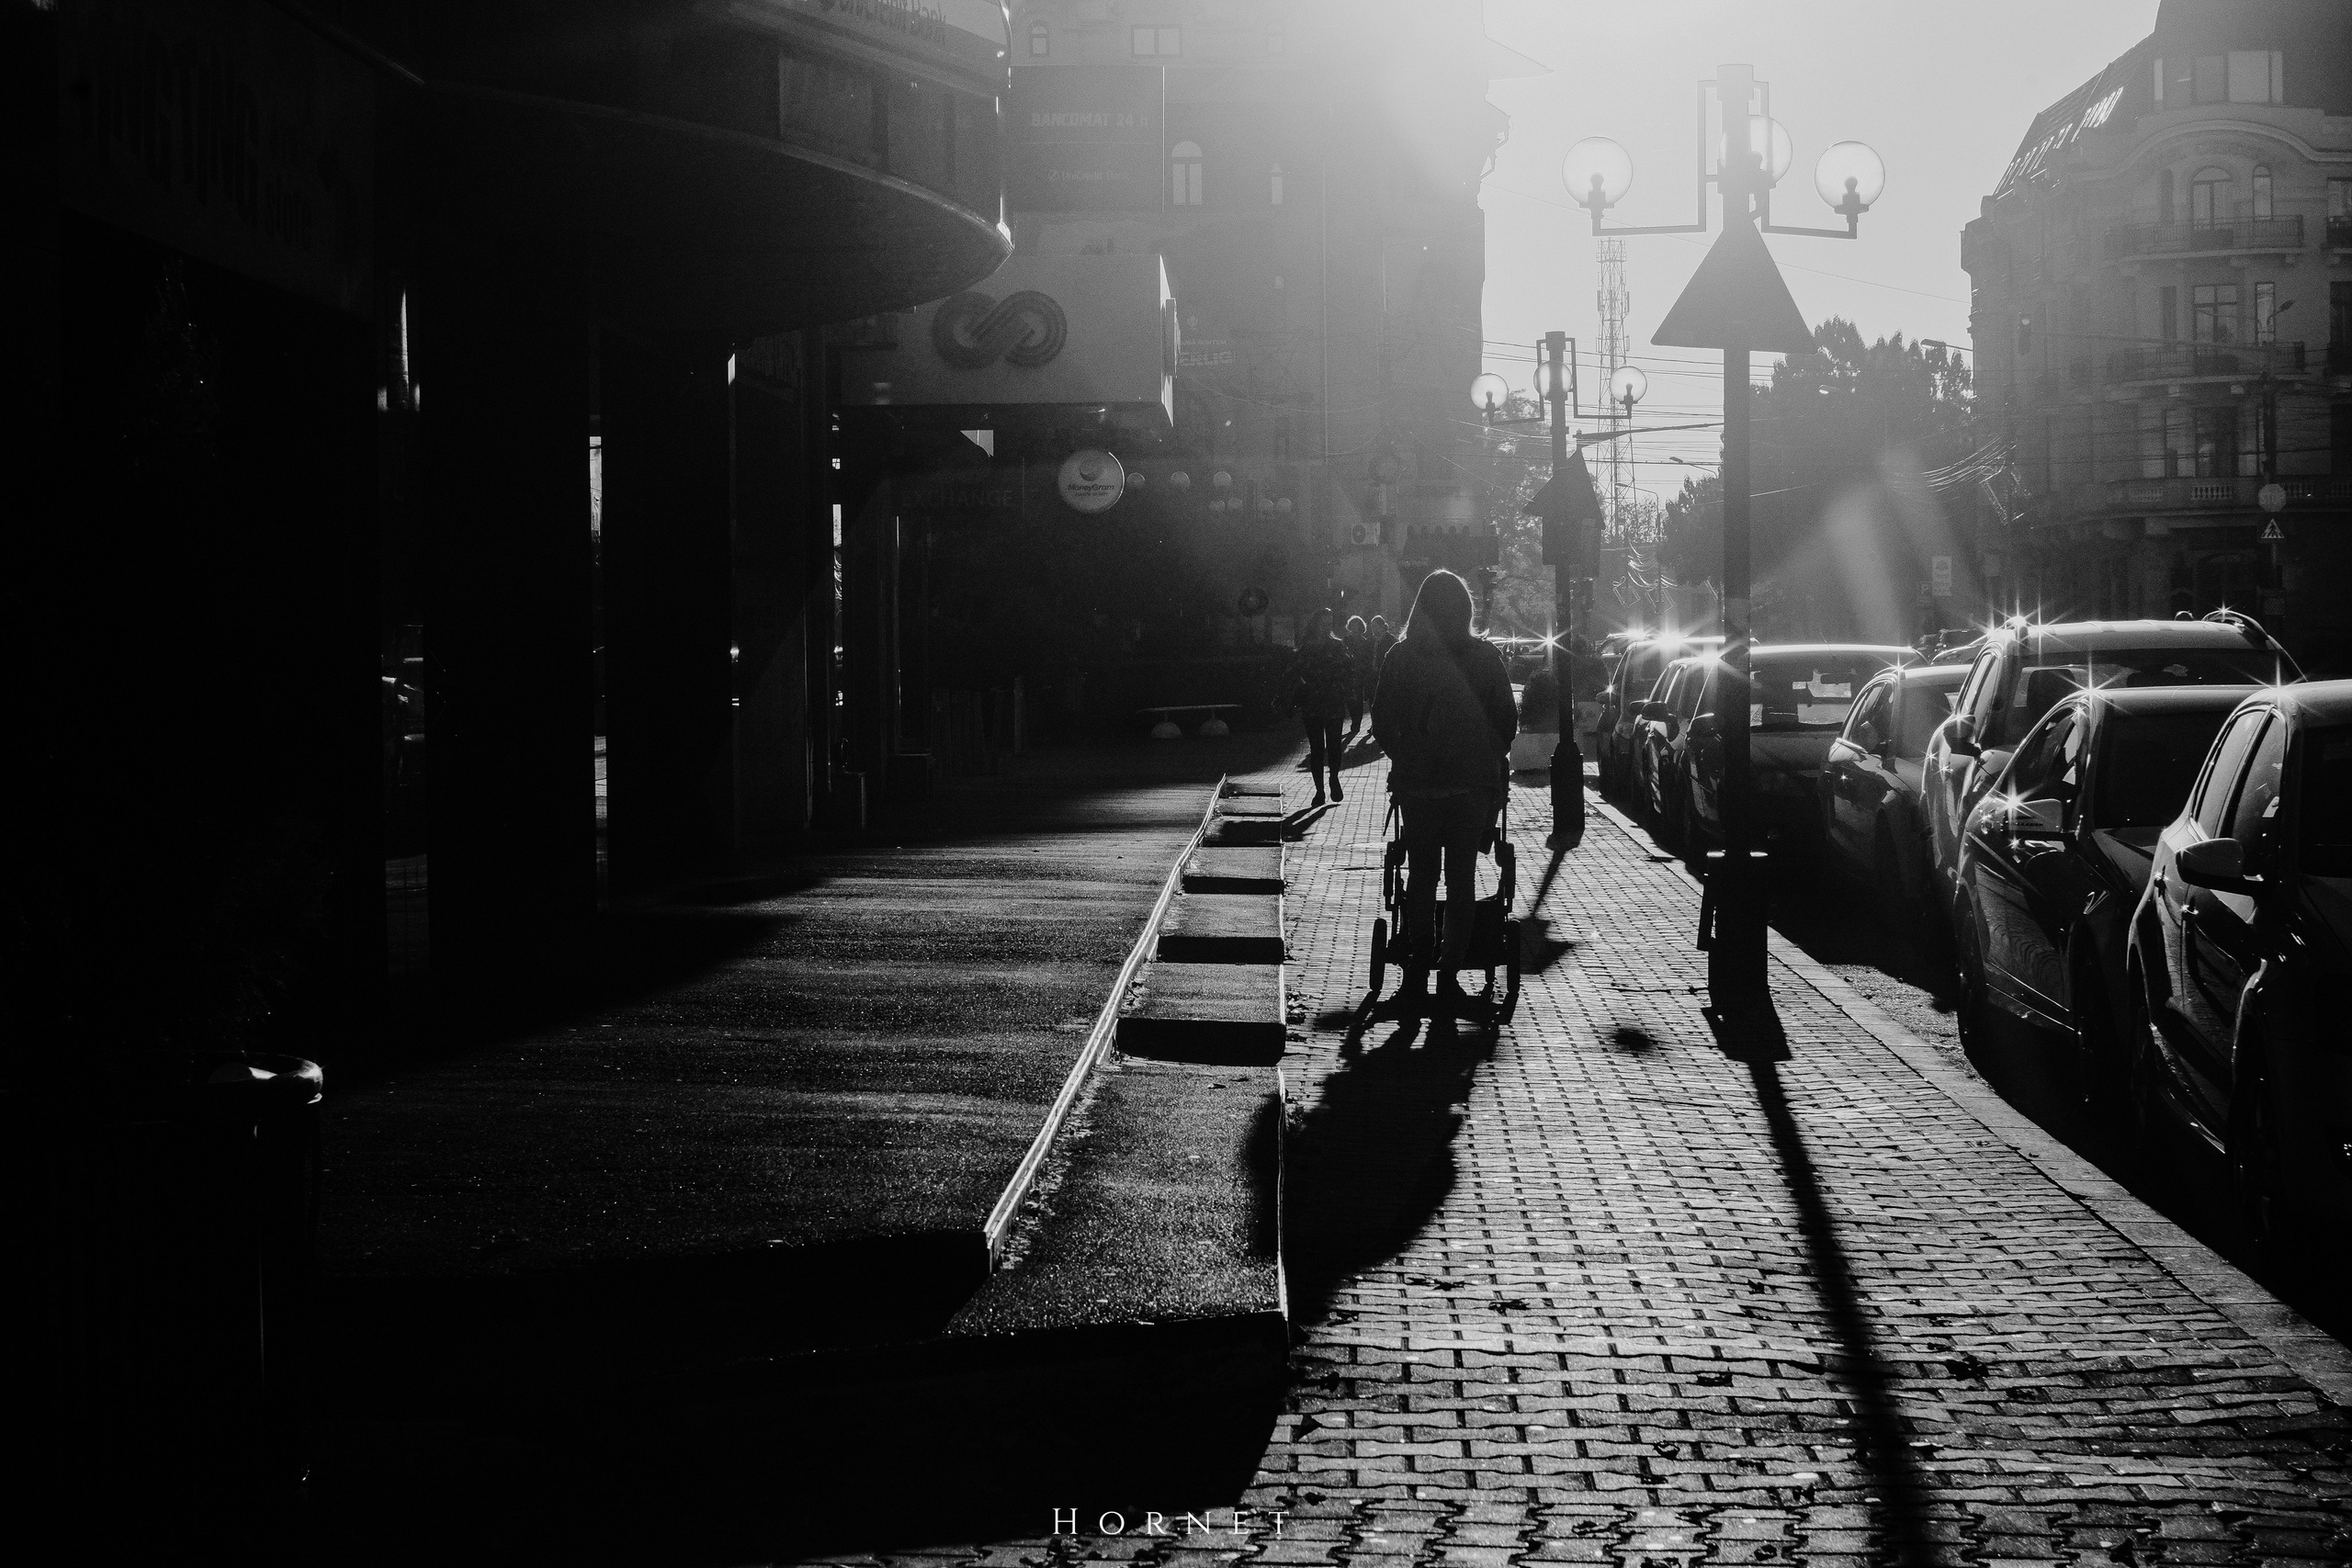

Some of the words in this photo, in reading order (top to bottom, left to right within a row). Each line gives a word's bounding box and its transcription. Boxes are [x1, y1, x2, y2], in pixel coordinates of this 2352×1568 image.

[1030, 112, 1111, 127] BANCOMAT
[1116, 112, 1135, 127] 24
[1068, 483, 1114, 492] MoneyGram
[900, 489, 1014, 507] EXCHANGE
